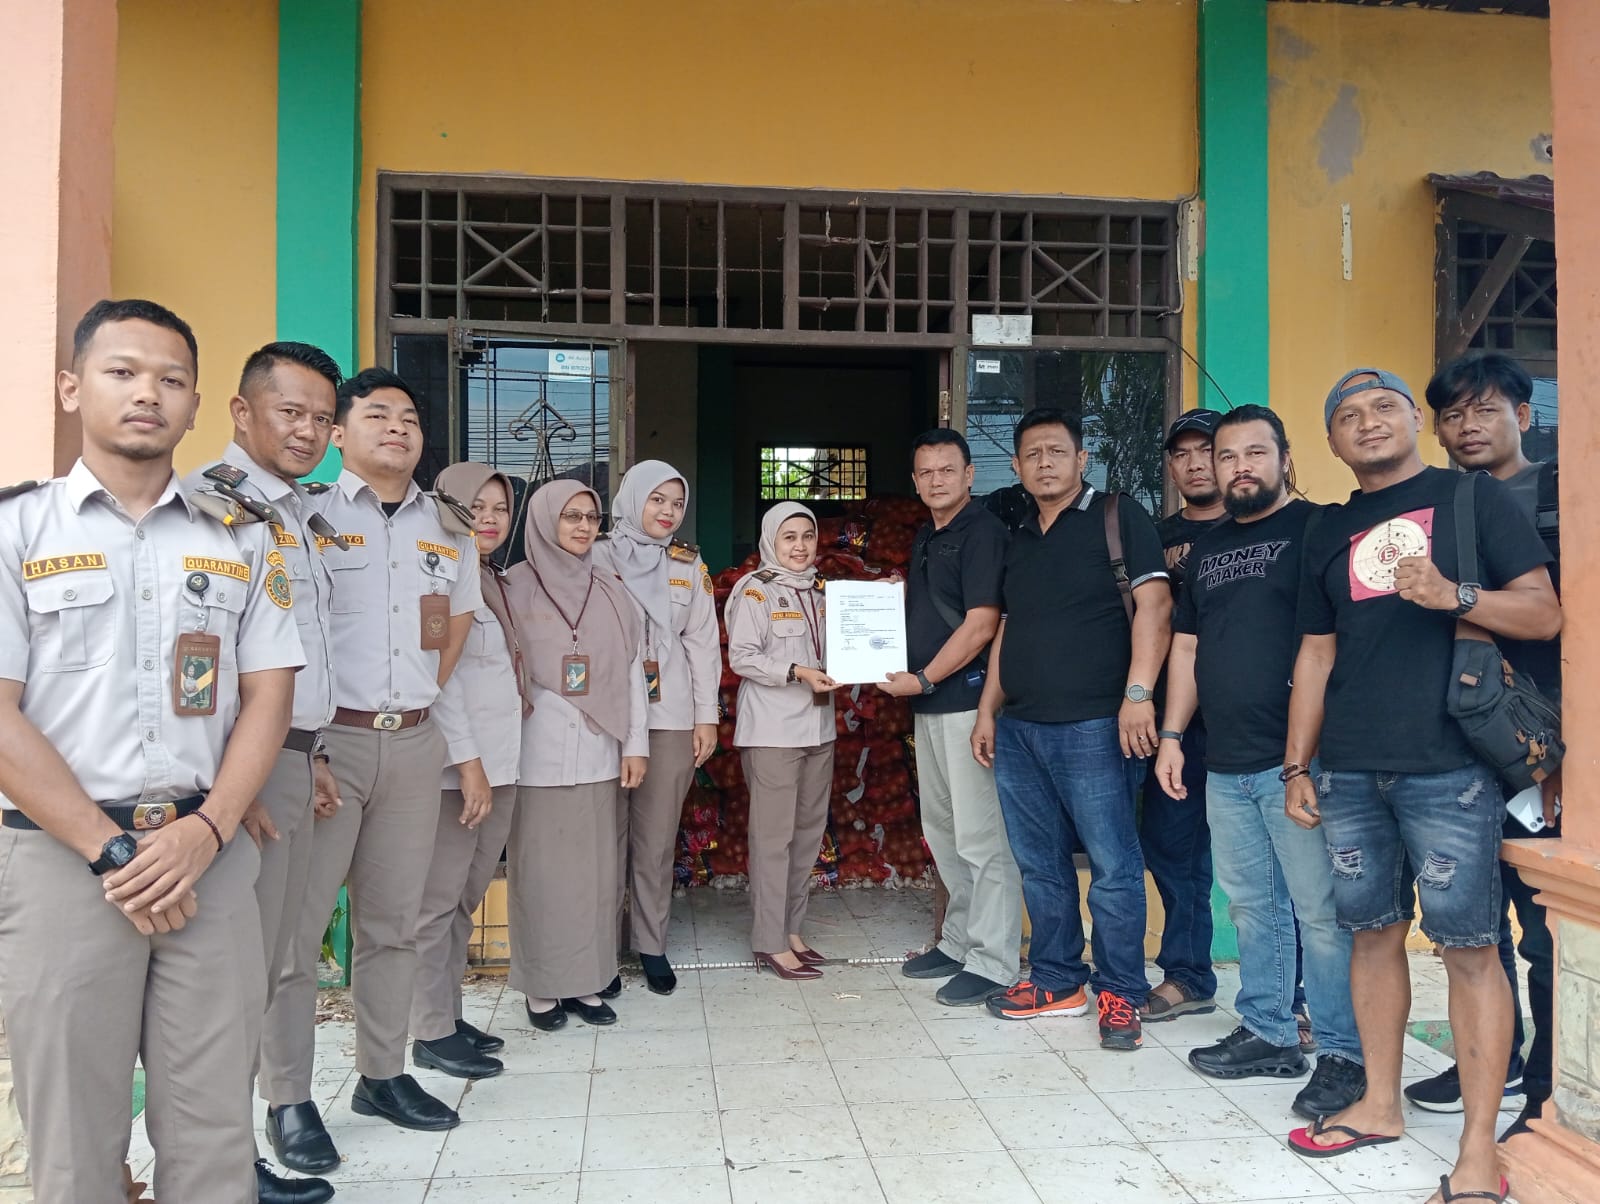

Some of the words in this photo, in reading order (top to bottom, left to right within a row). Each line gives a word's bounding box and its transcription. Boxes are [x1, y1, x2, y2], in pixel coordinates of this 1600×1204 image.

[31, 555, 98, 574] HASAN
[187, 559, 249, 578] QUARANTINE
[1199, 541, 1285, 578] MONEY
[1207, 561, 1265, 590] MAKER
